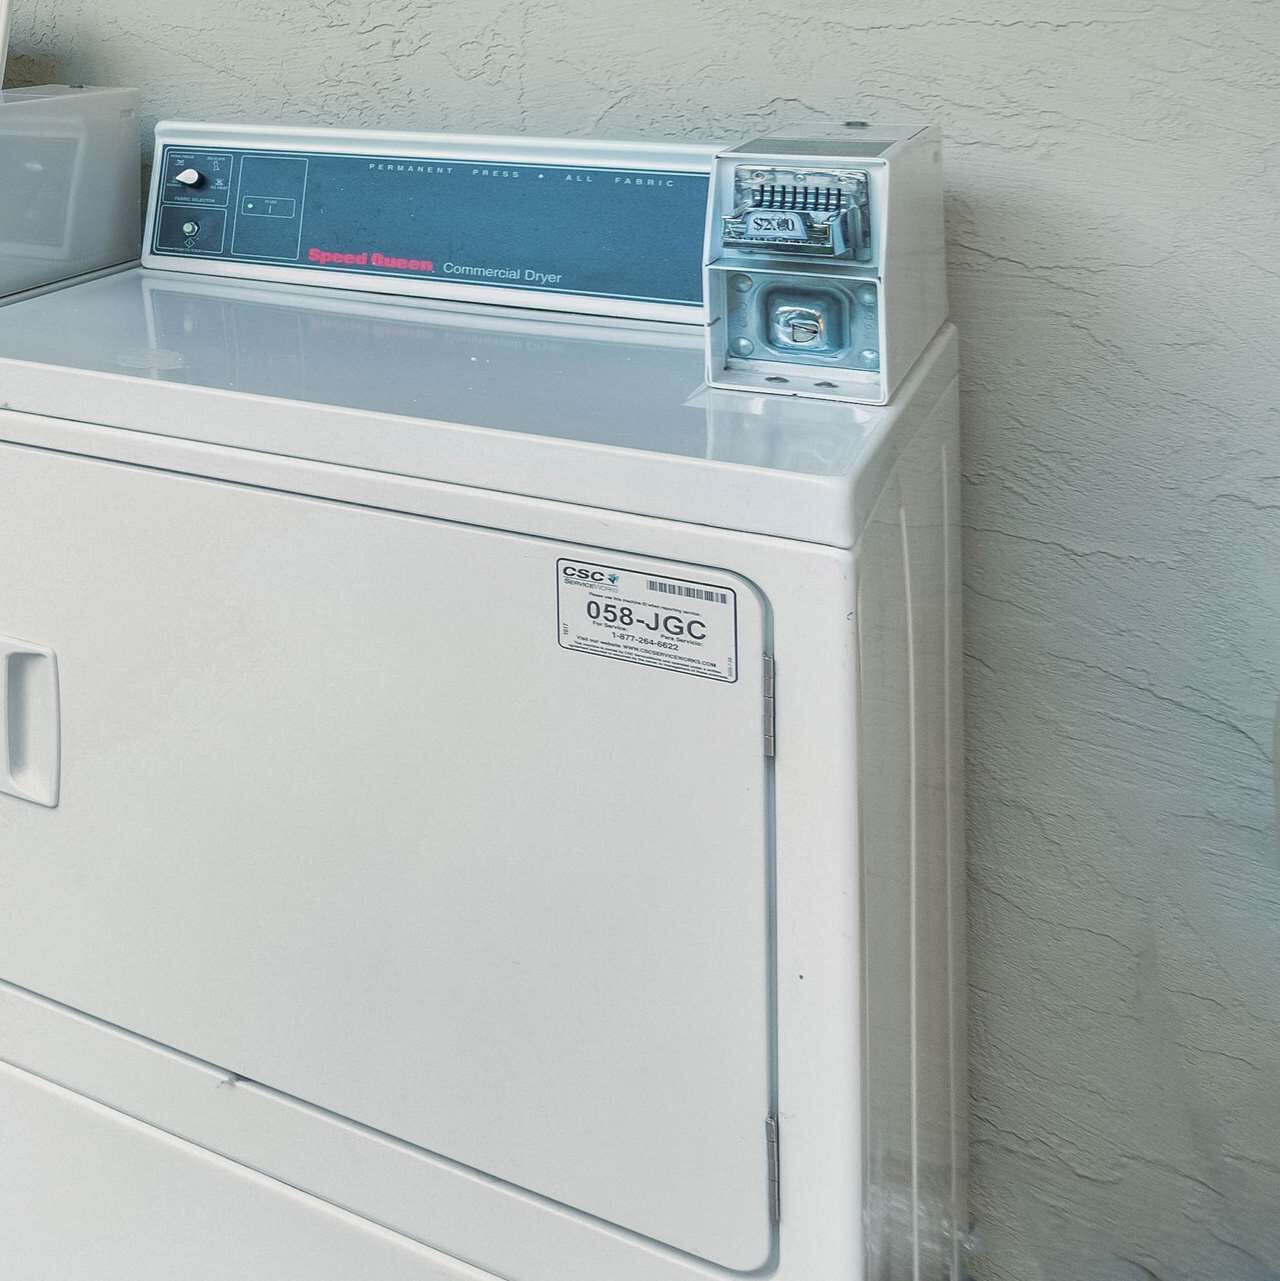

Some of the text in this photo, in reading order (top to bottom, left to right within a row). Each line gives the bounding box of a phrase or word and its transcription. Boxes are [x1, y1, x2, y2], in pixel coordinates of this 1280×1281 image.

[369, 163, 675, 187] PERMANENT PRESS ALL FABRIC
[308, 247, 562, 285] Speed Queen Commercial Dryer
[563, 566, 605, 582] CSC
[587, 600, 706, 640] 058-JGC
[612, 631, 679, 651] 1-877-264-6622
